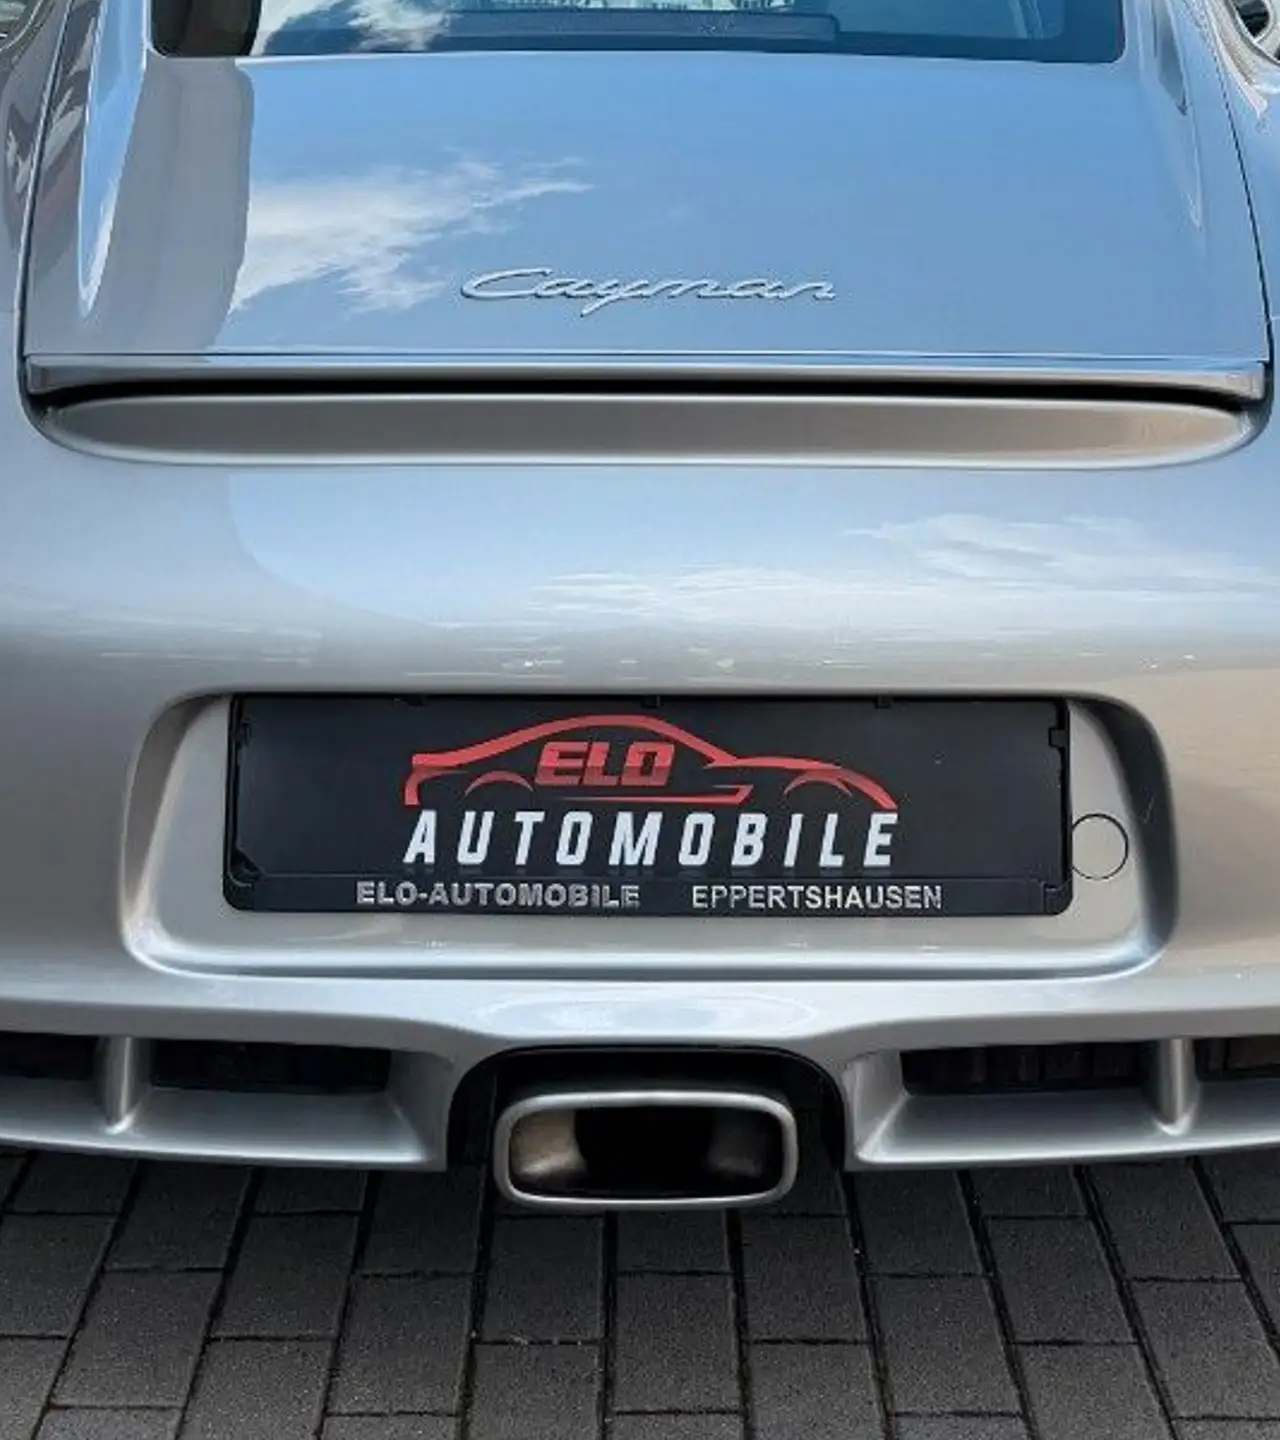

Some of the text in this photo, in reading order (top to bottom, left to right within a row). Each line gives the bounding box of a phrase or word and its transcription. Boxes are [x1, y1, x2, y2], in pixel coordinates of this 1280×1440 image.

[460, 266, 837, 319] Cayman
[534, 740, 676, 787] ELO
[403, 808, 900, 868] AUTOMOBILE
[356, 880, 943, 911] ELO-AUTOMOBILE EPPERTSHAUSEN
